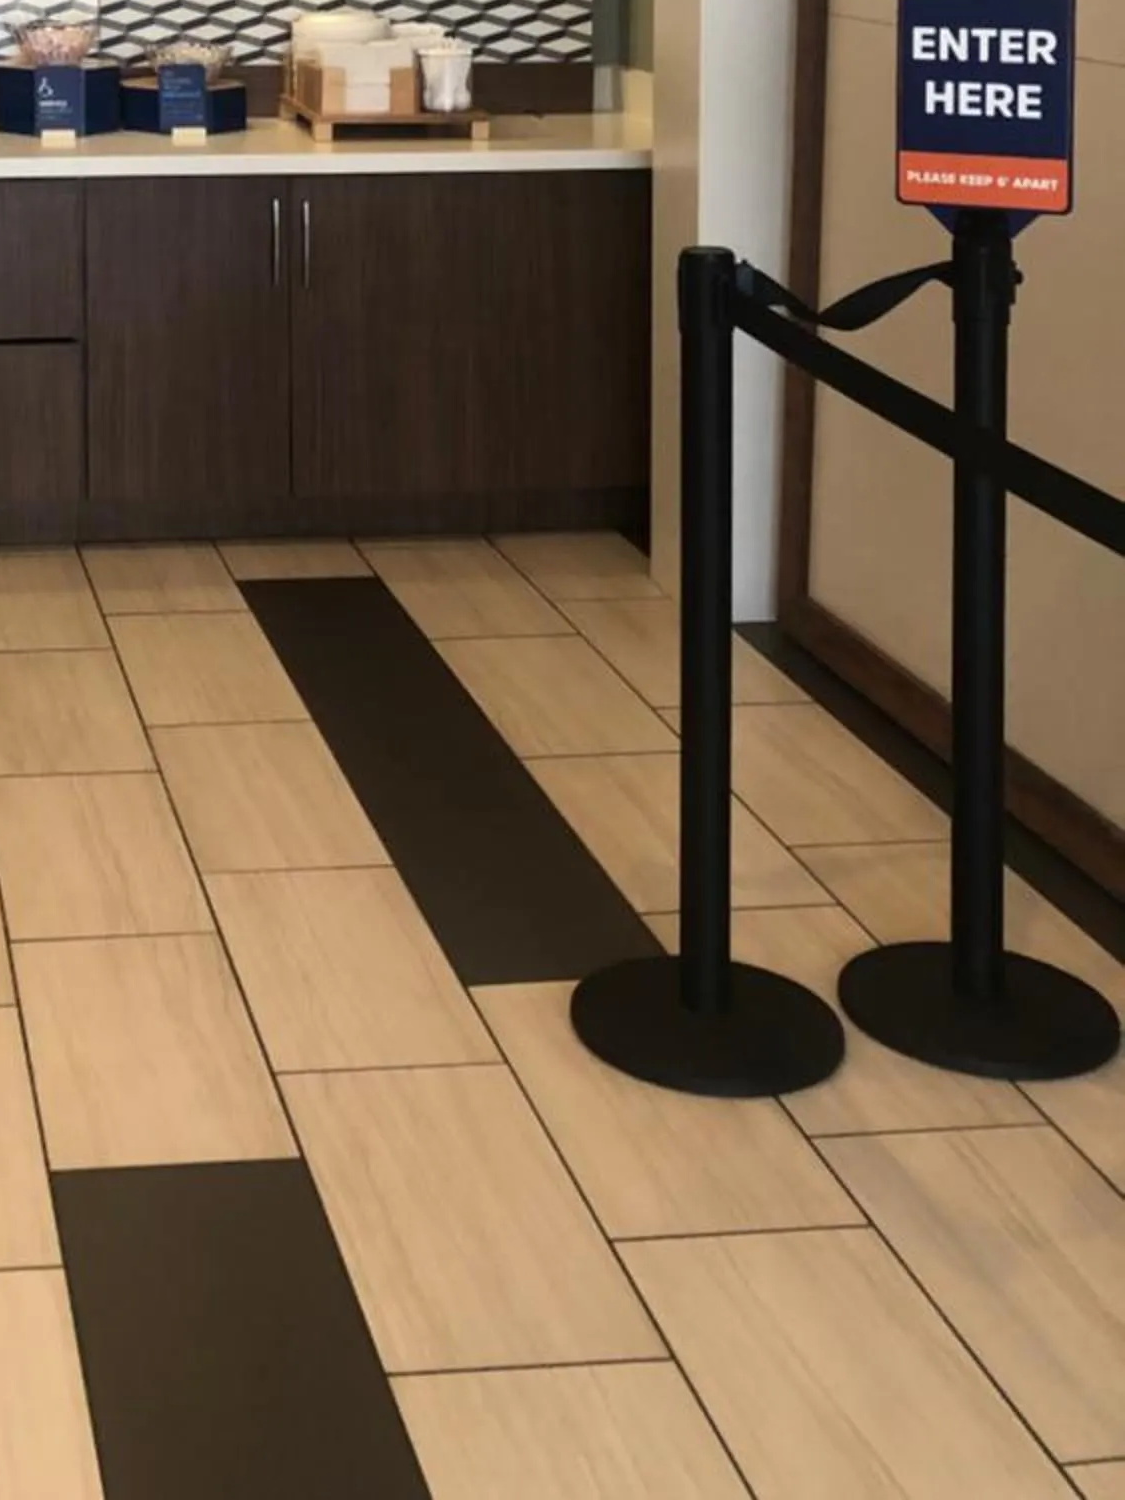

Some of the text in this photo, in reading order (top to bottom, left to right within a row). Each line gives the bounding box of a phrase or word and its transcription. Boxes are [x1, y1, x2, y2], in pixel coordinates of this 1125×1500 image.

[911, 25, 1058, 66] ENTER
[924, 80, 1043, 120] HERE
[906, 170, 956, 185] PLEASE
[959, 173, 993, 187] KEEP
[1012, 176, 1058, 192] APART
